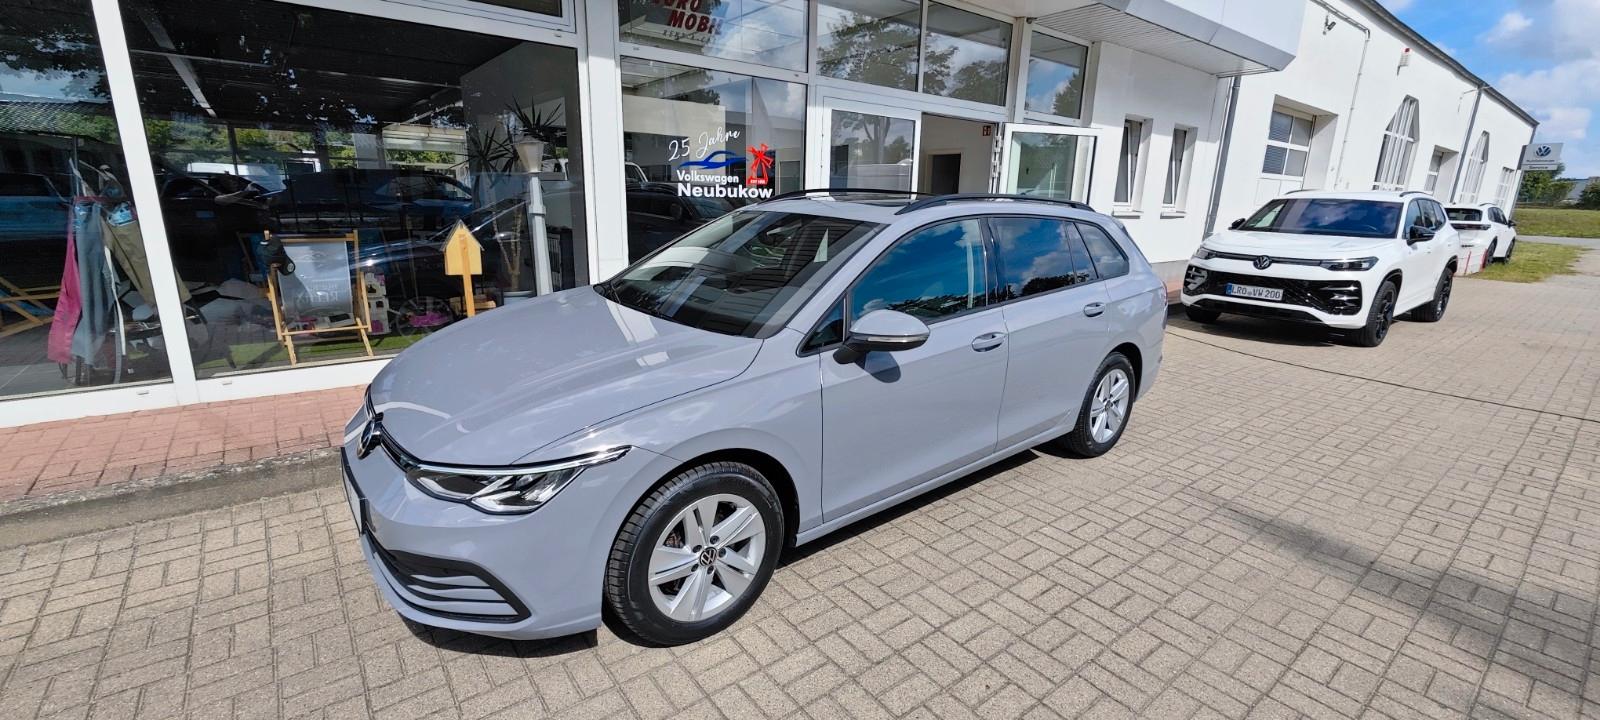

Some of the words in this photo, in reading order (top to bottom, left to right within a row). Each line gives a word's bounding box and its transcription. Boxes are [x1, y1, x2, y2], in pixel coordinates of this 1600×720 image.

[668, 138, 690, 162] 25
[696, 127, 740, 159] Jahre
[677, 170, 739, 185] Volkswagen
[678, 183, 773, 198] Neubukow
[1232, 286, 1247, 295] LRO
[1253, 288, 1264, 297] VW
[1264, 290, 1280, 299] 200
